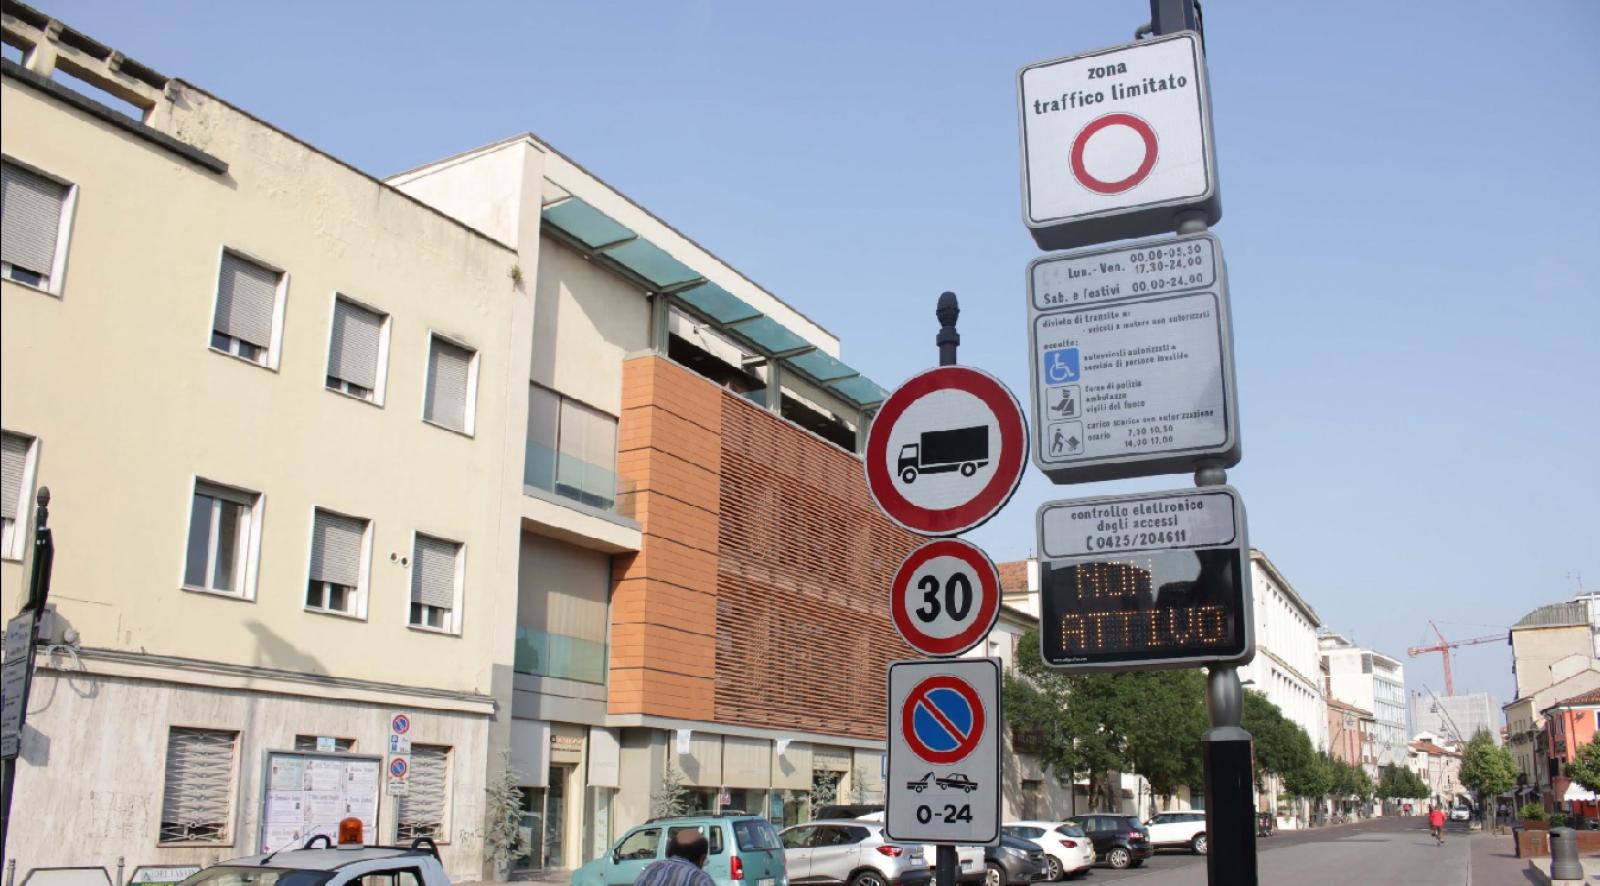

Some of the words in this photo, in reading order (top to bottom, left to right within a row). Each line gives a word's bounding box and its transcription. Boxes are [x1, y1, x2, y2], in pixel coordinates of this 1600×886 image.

[1087, 62, 1127, 79] zona
[1033, 91, 1104, 114] traffico
[1111, 73, 1187, 100] limitato
[1071, 506, 1127, 520] controllo
[1133, 500, 1203, 516] elettronico
[1133, 515, 1178, 529] accessi
[1076, 558, 1152, 598] NON
[916, 573, 972, 622] 30
[1061, 605, 1220, 651] ATTIVO
[916, 804, 973, 824] 0-24
